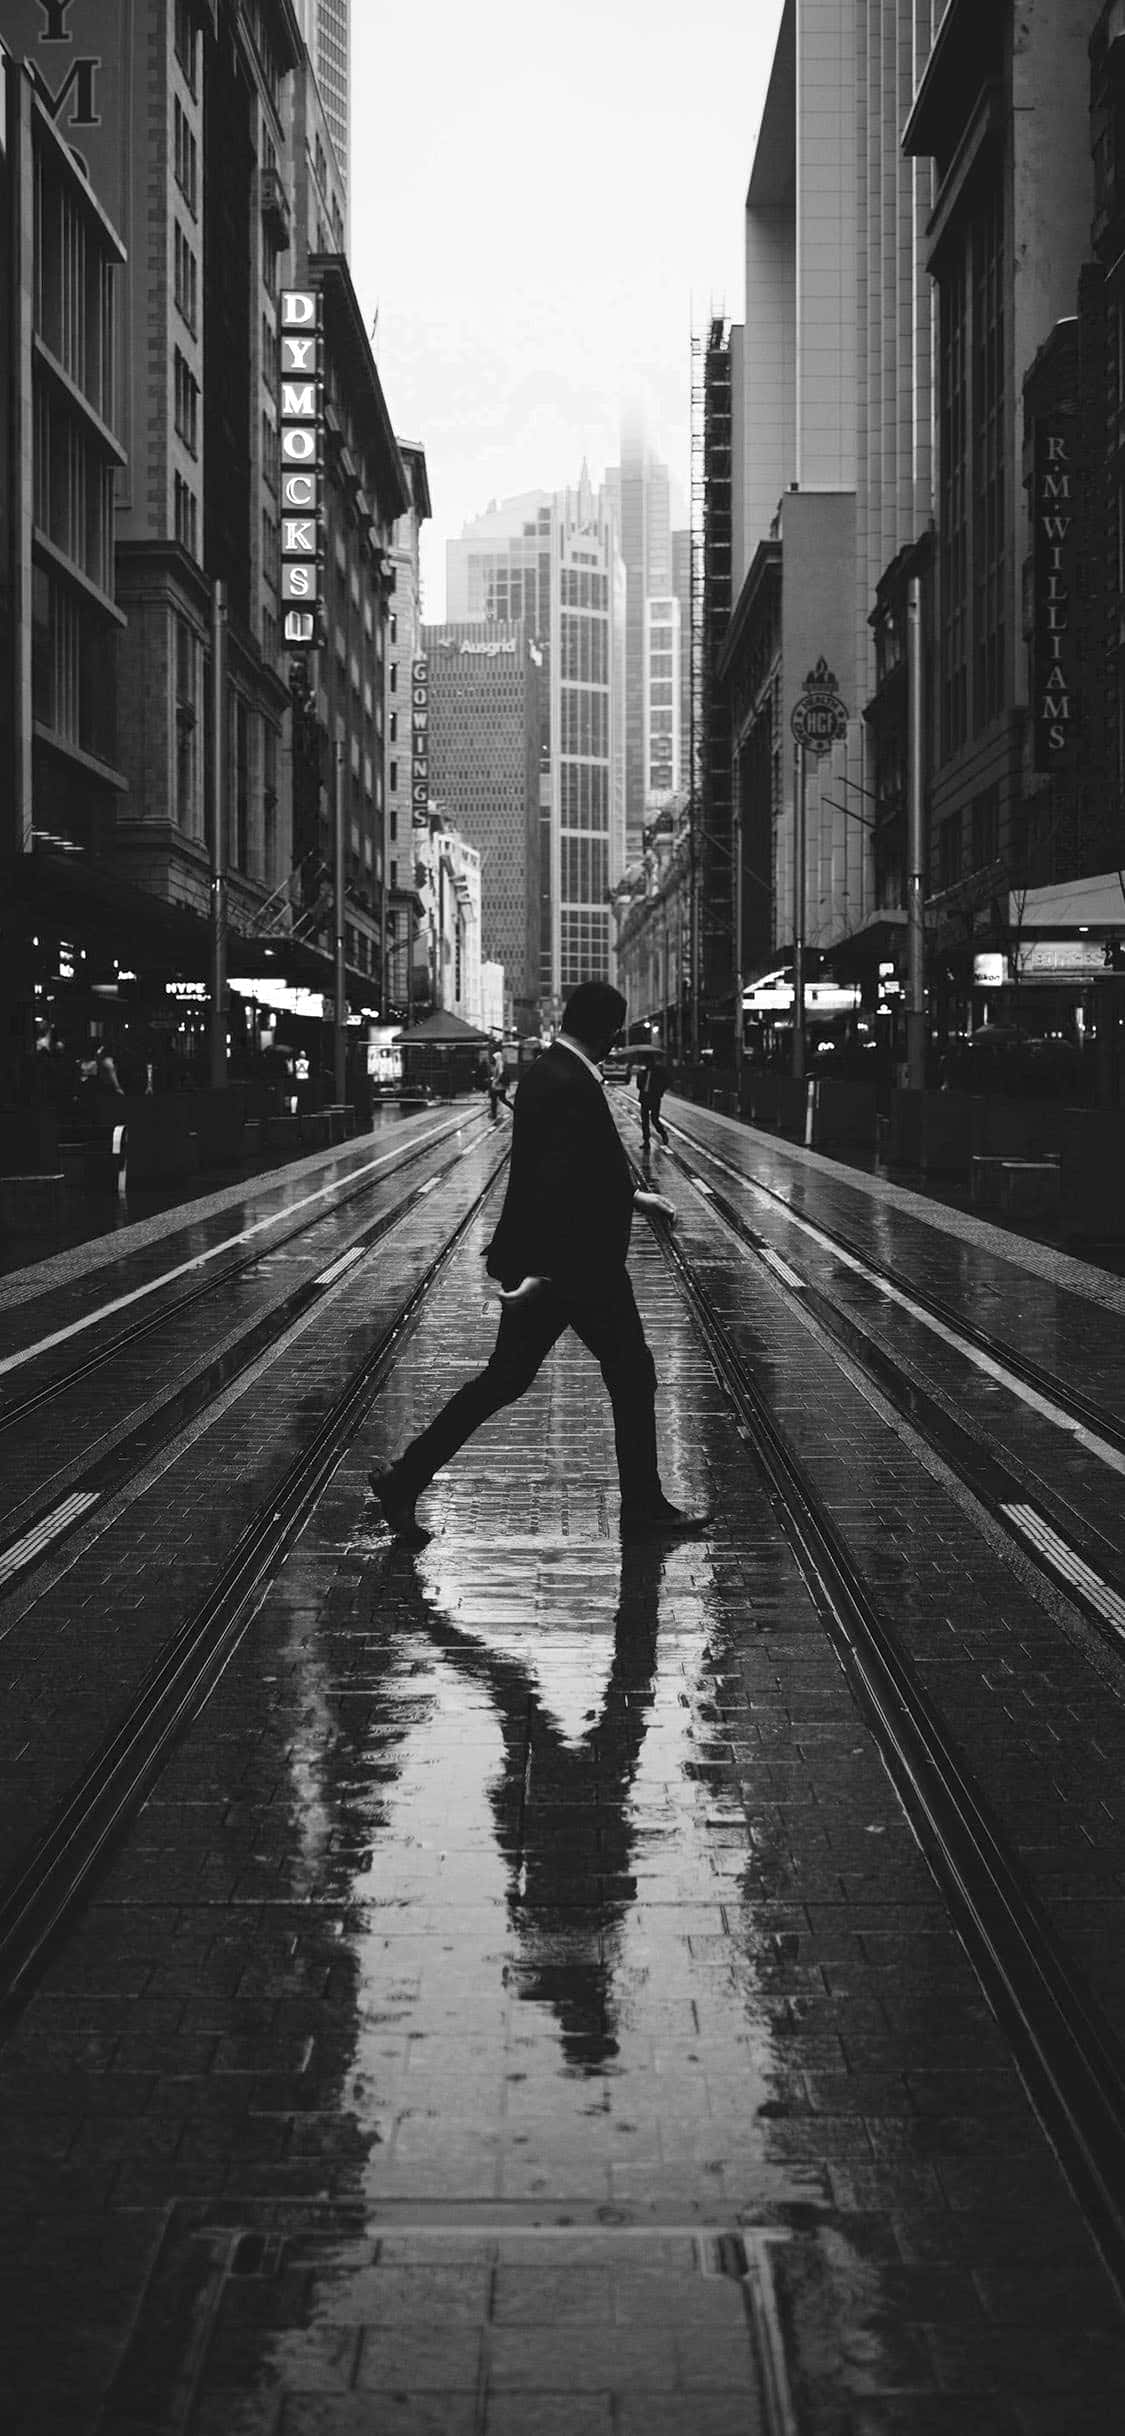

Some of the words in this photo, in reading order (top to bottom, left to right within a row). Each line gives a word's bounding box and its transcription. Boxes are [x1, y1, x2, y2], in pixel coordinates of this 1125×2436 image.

[285, 293, 313, 596] DYMOCKS
[460, 639, 516, 656] Ausgrid
[413, 664, 426, 824] GOWINGS
[166, 982, 206, 994] HYPE
